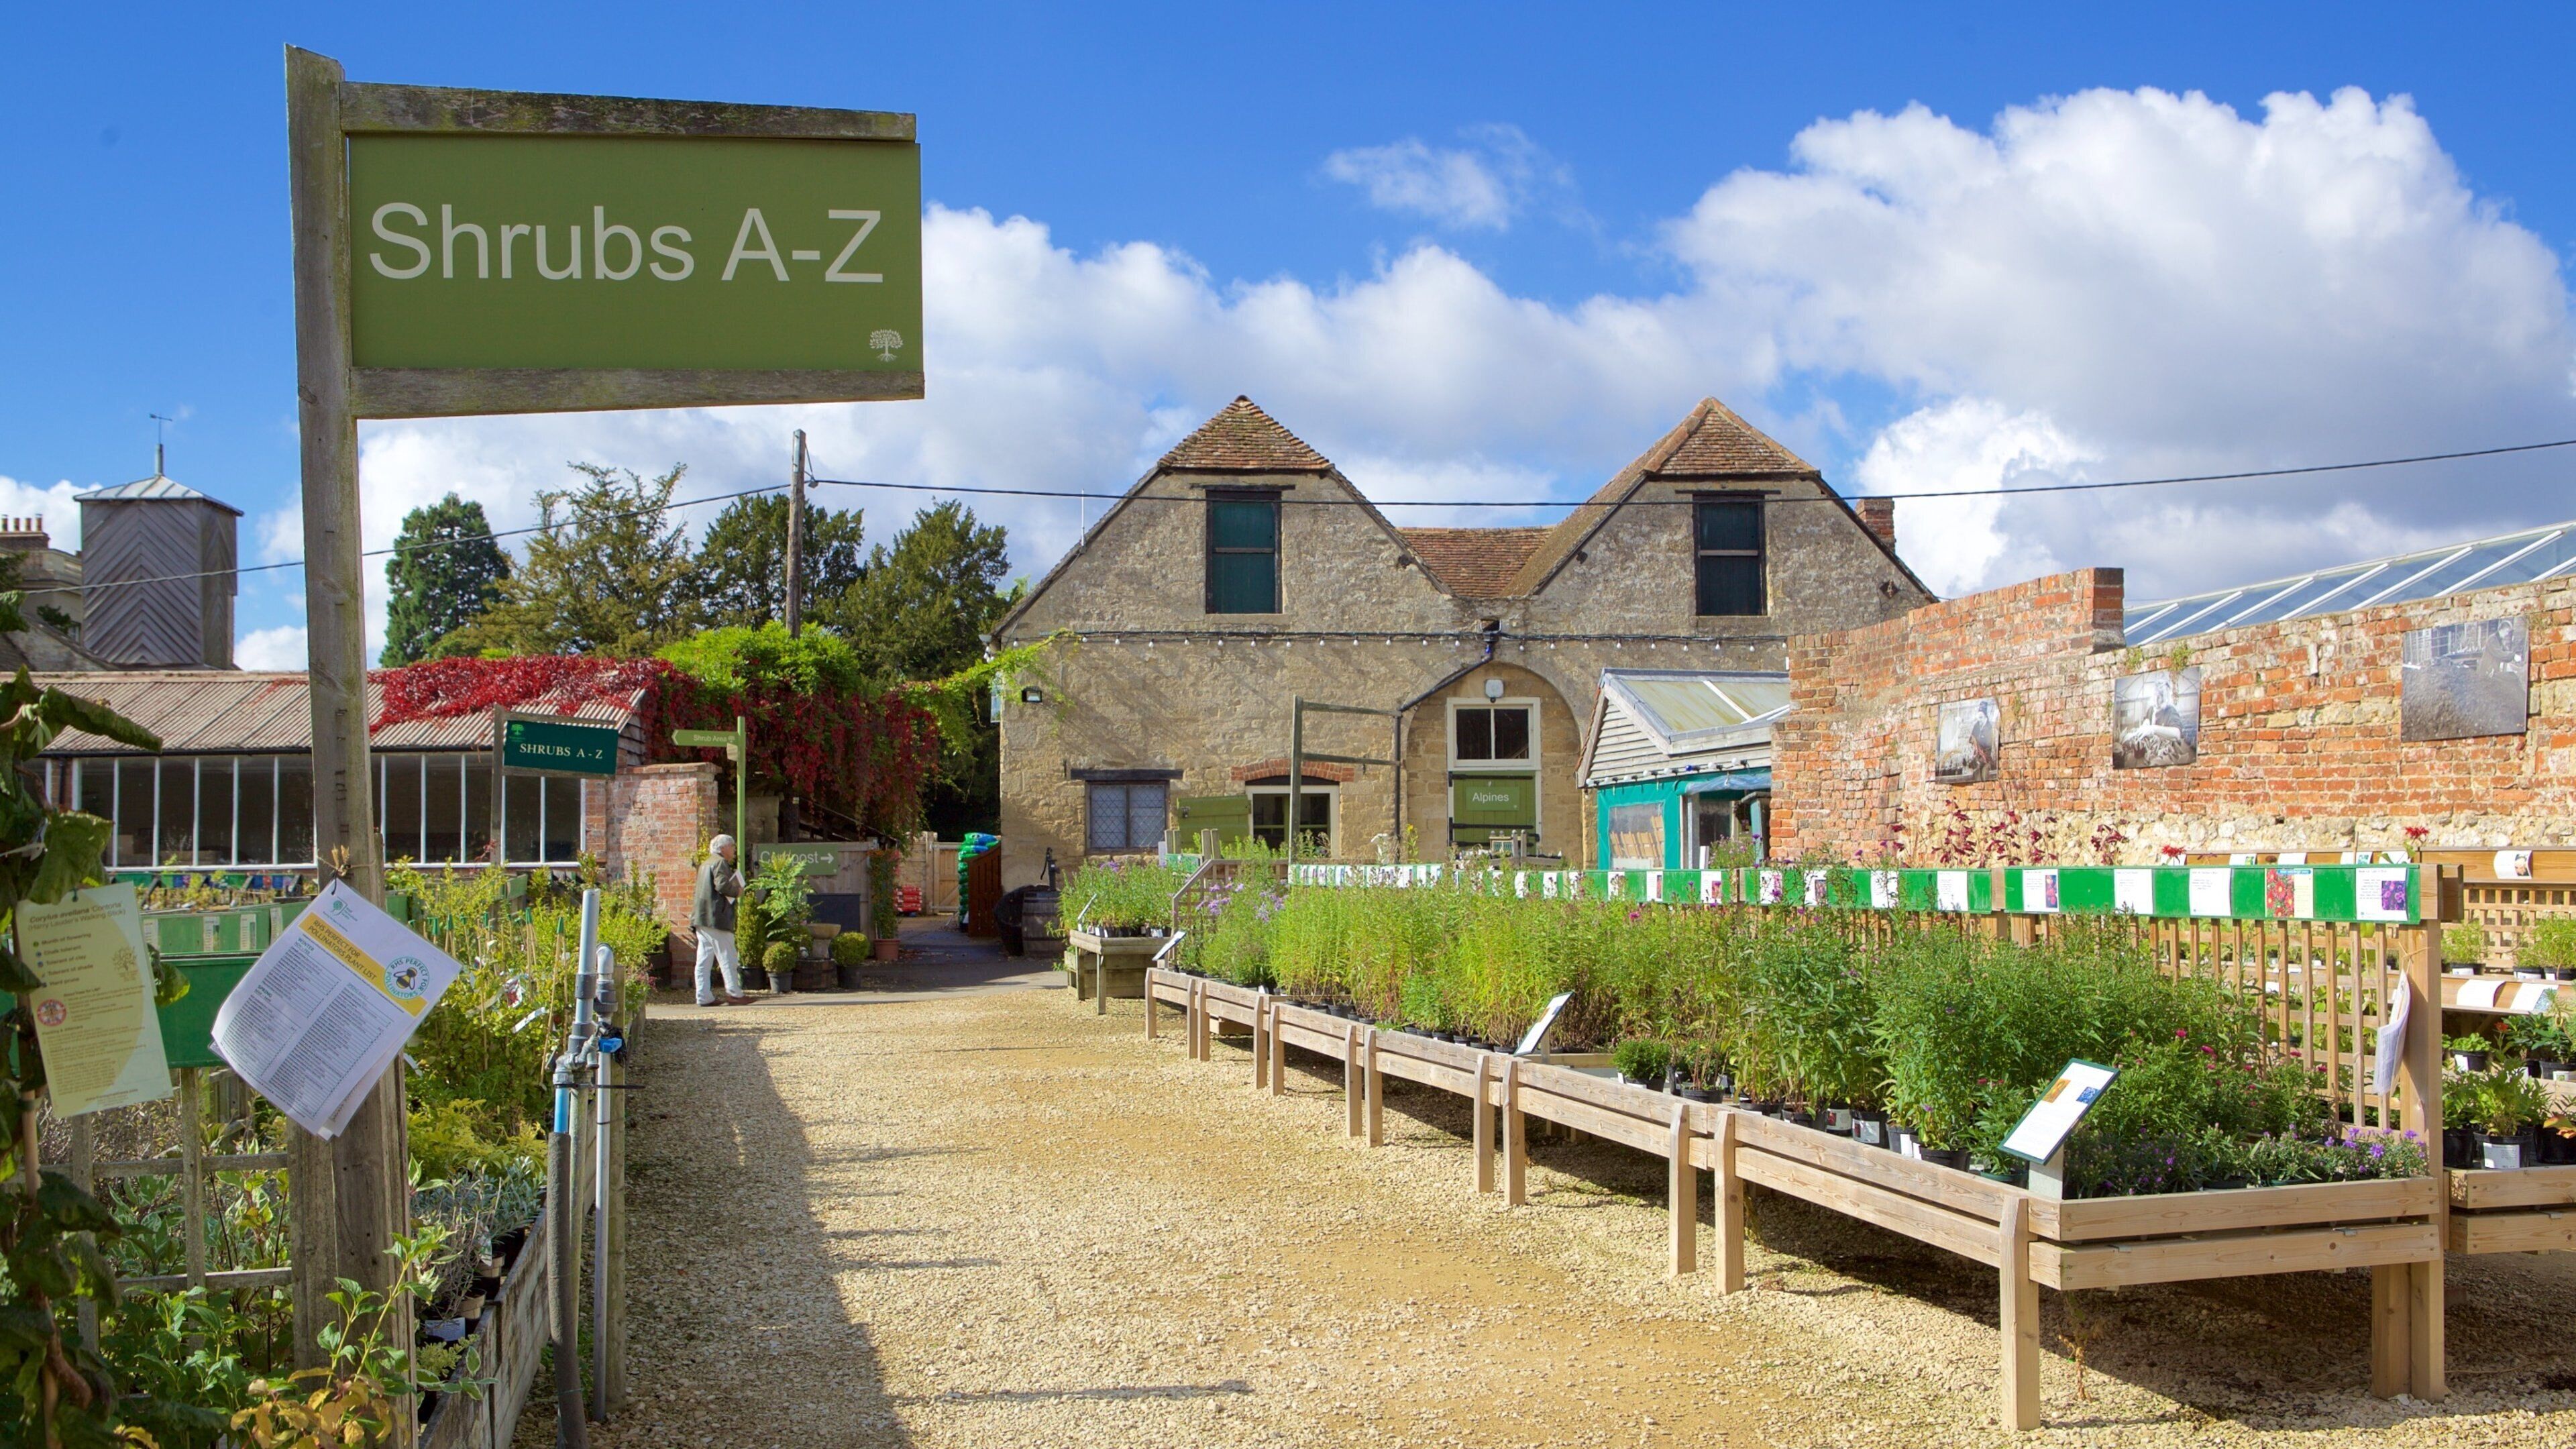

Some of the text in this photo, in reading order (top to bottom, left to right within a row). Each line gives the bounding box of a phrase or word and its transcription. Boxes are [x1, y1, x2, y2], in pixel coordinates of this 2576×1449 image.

[370, 202, 883, 283] Shrubs A-Z
[519, 743, 571, 757] SHRUBS
[1472, 792, 1509, 804] Alpines
[80, 912, 106, 922] Walking
[308, 926, 376, 980] POLLINATORS PLANT LIST
[313, 920, 325, 931] RHS
[325, 929, 348, 949] PERFECT
[348, 947, 360, 957] FOR
[386, 971, 418, 998] POLLINATORS
[391, 958, 428, 994] RHS PERFECT FOR
